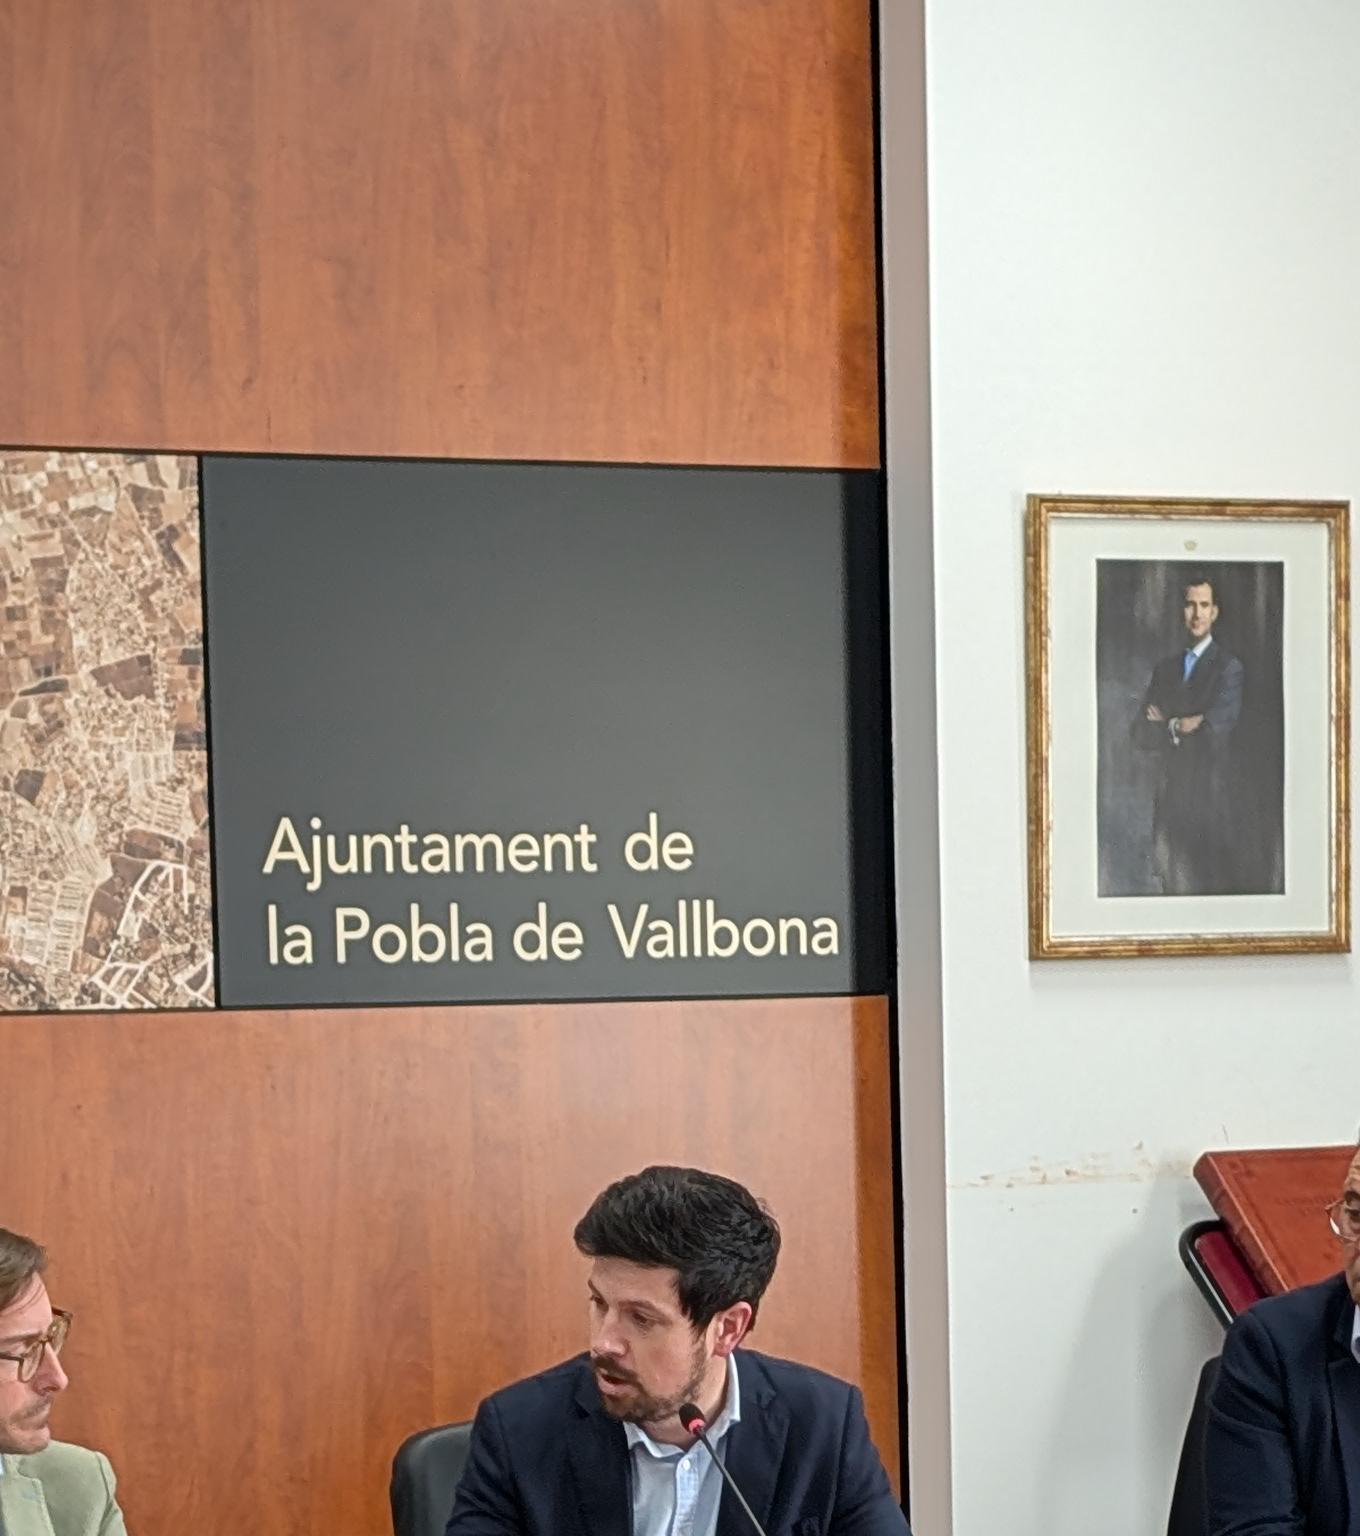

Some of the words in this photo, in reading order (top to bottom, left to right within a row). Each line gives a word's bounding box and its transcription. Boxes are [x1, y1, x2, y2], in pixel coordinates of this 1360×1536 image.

[262, 816, 598, 892] Ajuntament
[623, 812, 694, 872] de
[267, 903, 313, 965] la
[335, 902, 493, 964] Pobla
[513, 902, 584, 962] de
[608, 900, 839, 960] Vallbona
